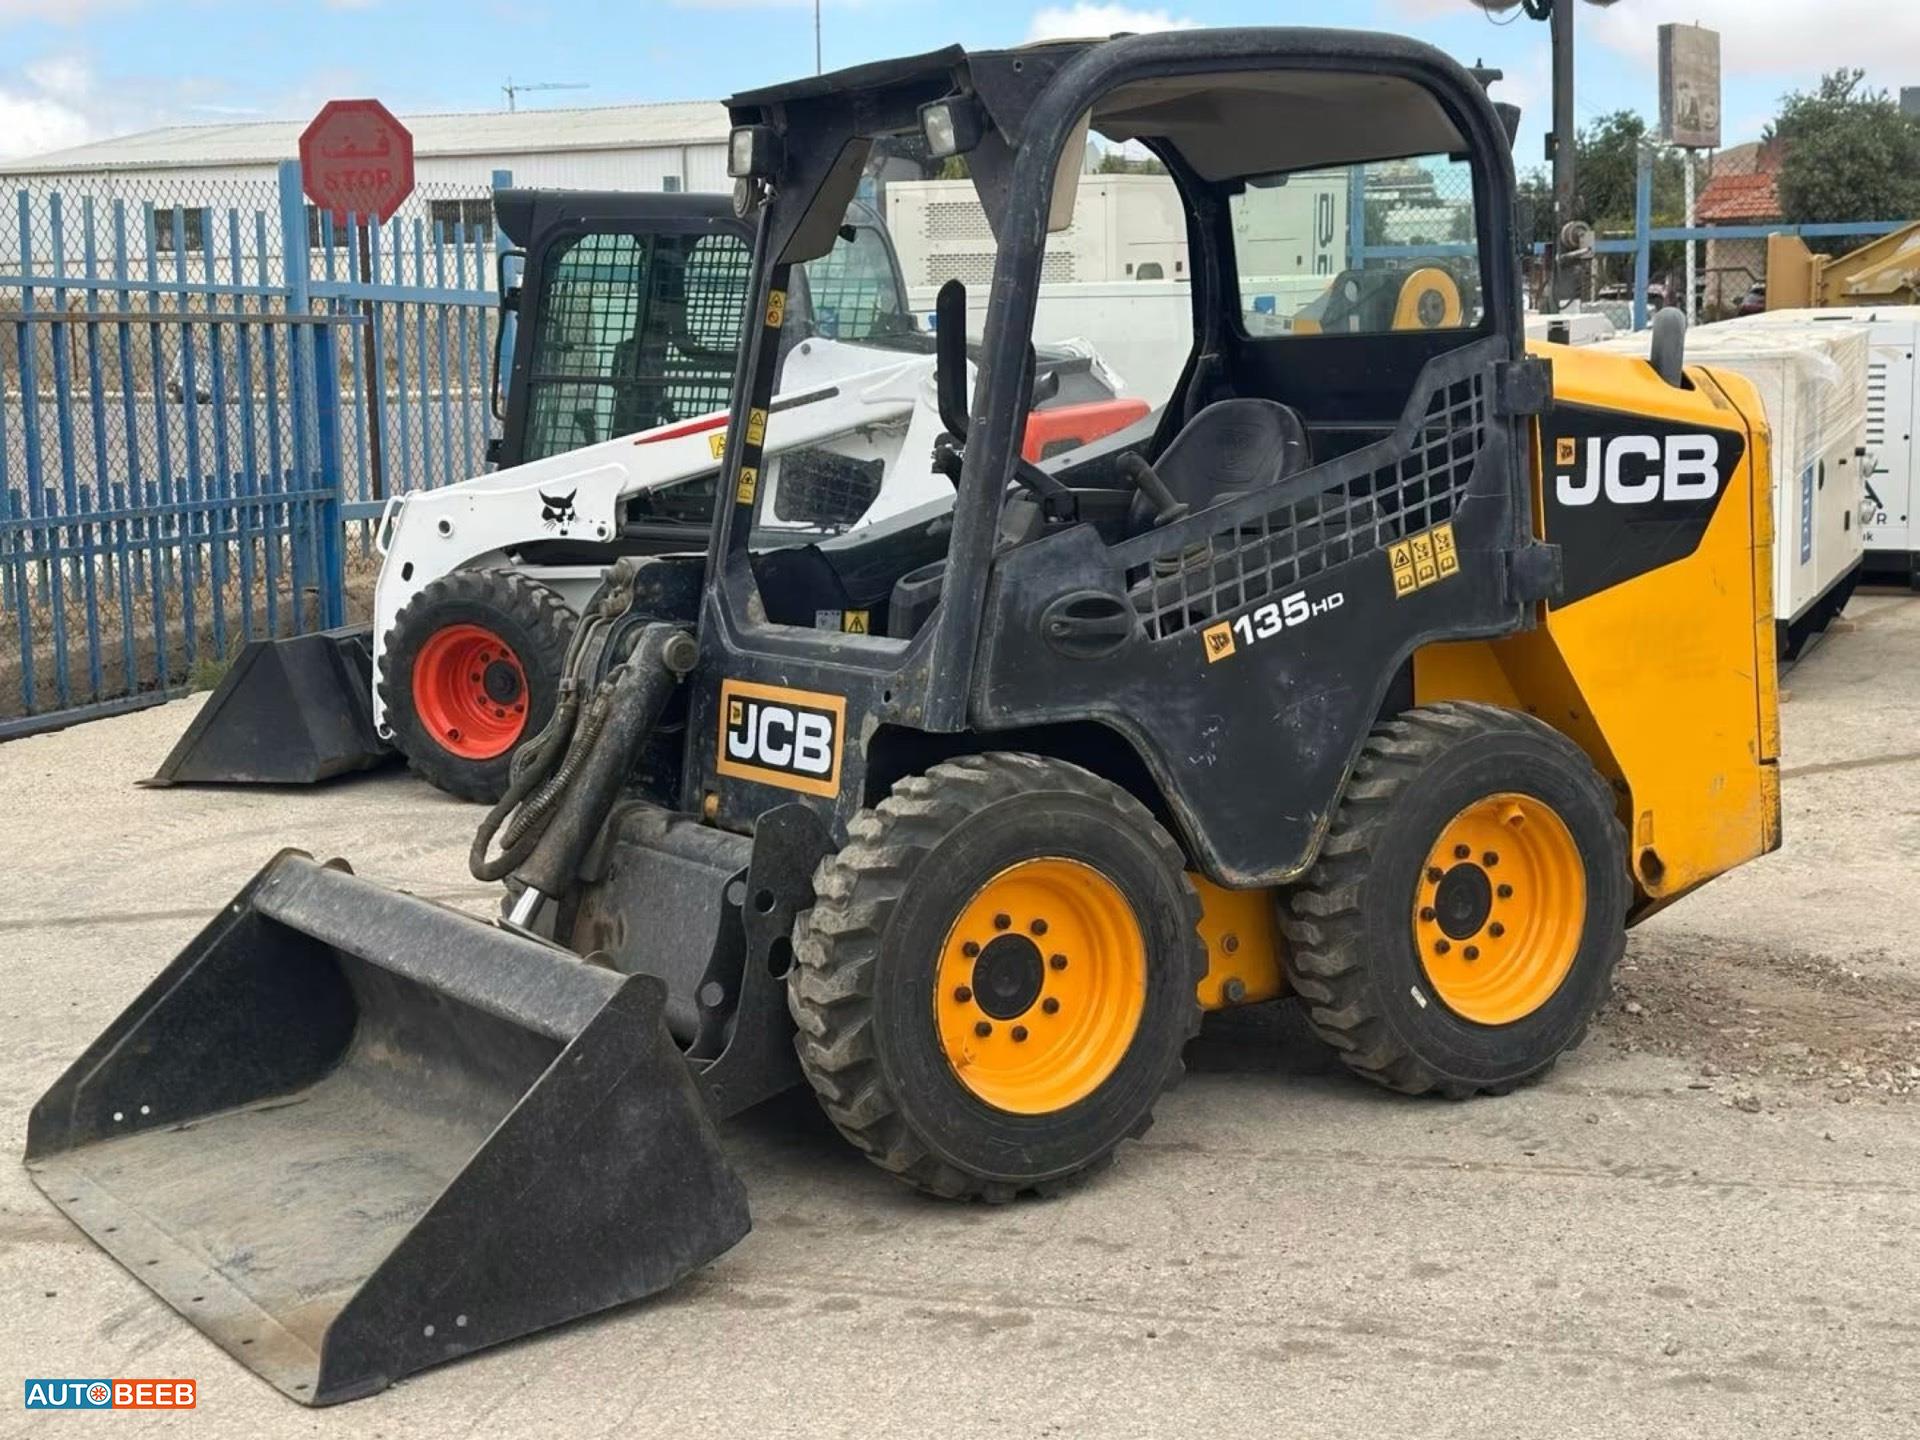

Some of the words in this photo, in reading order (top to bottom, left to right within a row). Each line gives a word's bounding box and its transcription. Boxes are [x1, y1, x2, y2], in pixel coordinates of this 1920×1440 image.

[324, 170, 391, 194] STOP
[1556, 434, 1719, 506] JCB
[728, 703, 832, 774] JCB
